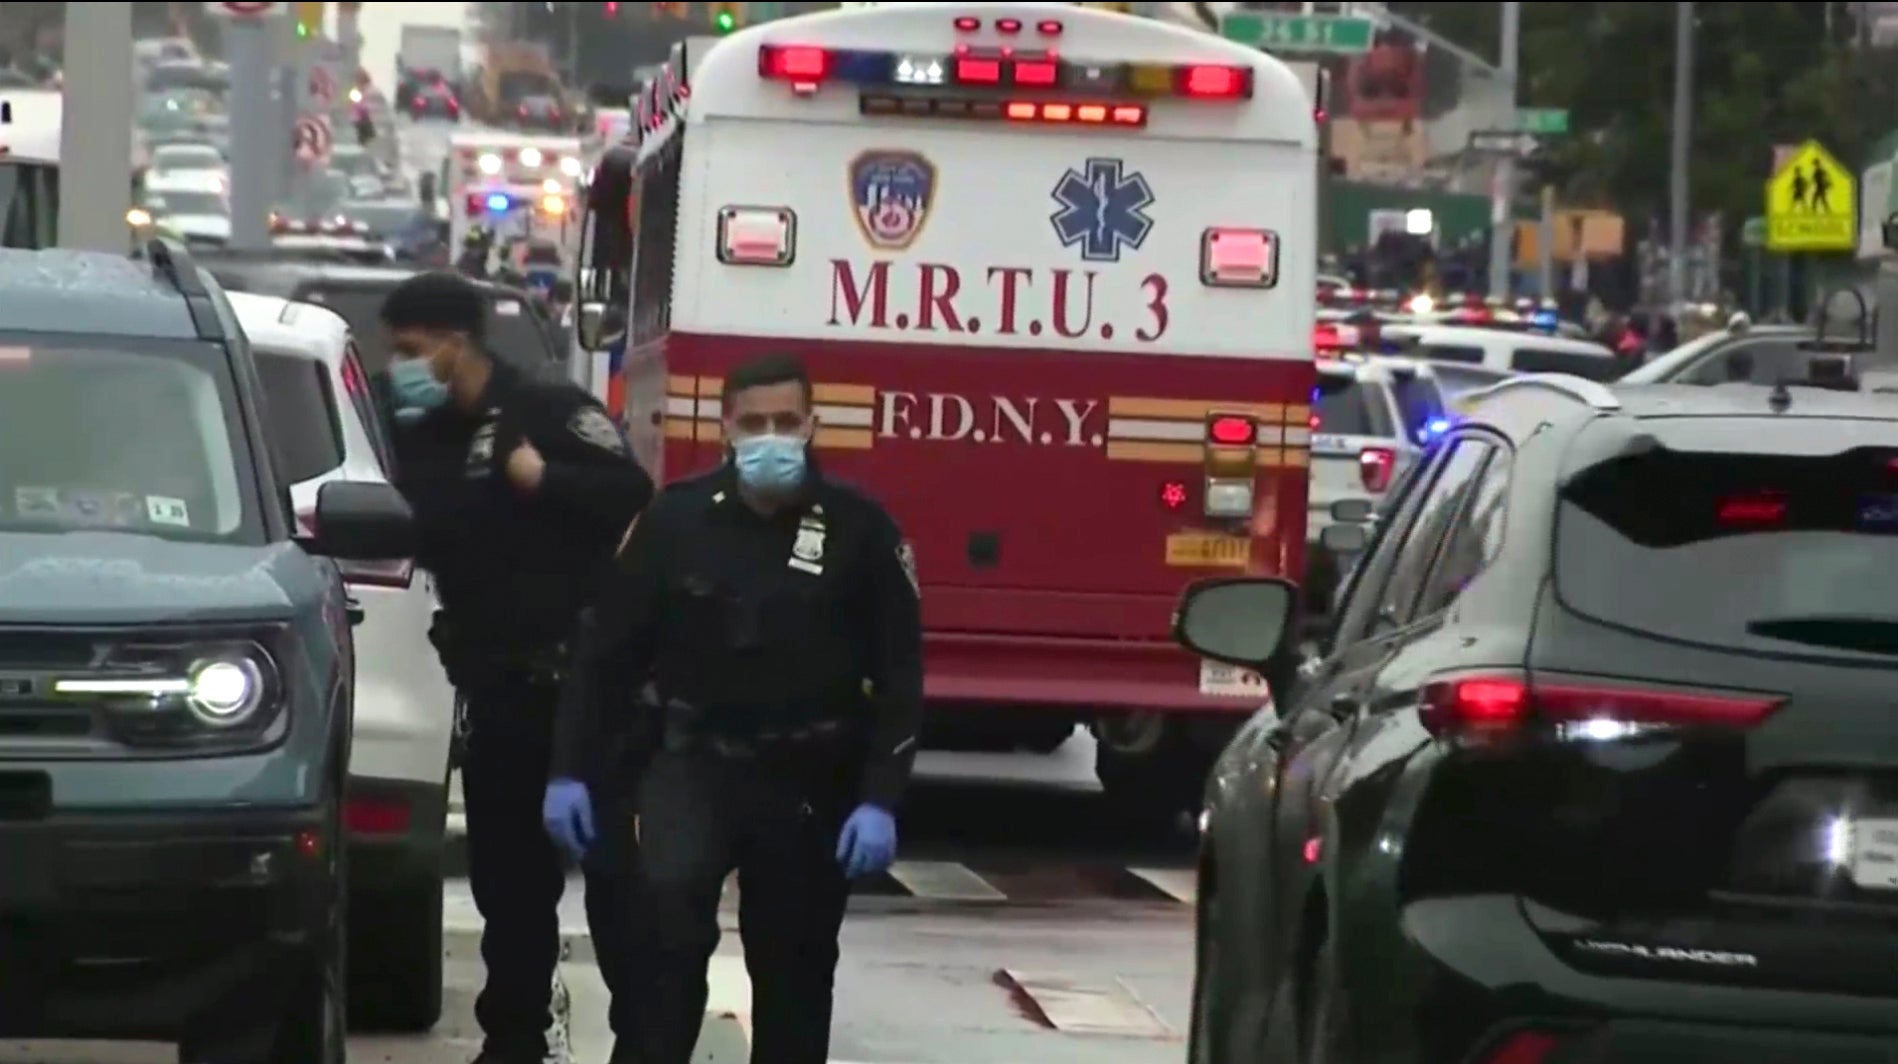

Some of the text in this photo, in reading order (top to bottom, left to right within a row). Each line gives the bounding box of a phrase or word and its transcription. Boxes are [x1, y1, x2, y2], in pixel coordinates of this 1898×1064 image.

[826, 258, 1169, 342] M.R.T.U. 3
[877, 390, 1104, 448] F.D.N.Y.
